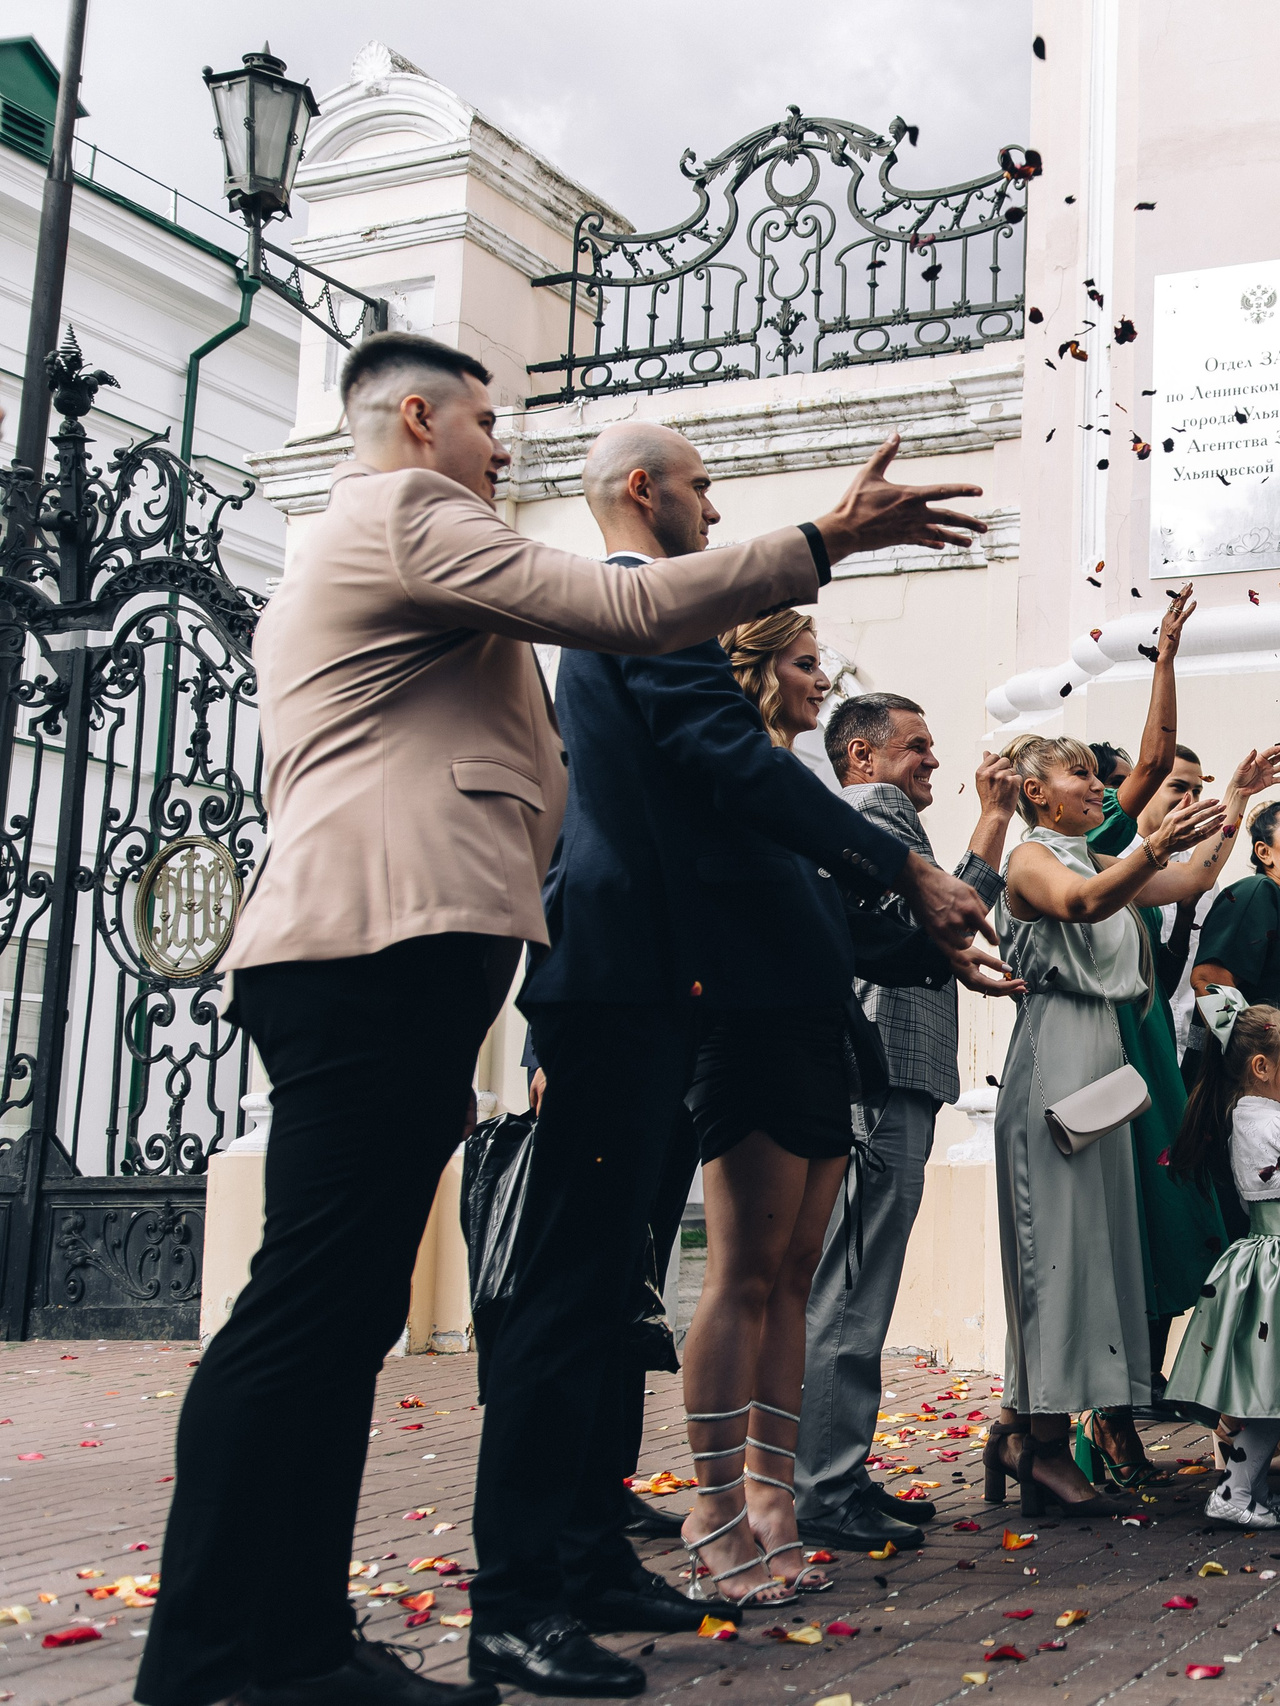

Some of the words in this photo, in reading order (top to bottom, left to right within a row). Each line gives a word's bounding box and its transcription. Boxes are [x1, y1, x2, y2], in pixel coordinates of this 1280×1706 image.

[1205, 357, 1253, 372] Отдел
[1166, 393, 1184, 403] по
[1182, 413, 1235, 430] города
[1187, 437, 1268, 454] Агентства
[1173, 458, 1274, 482] Ульяновской
